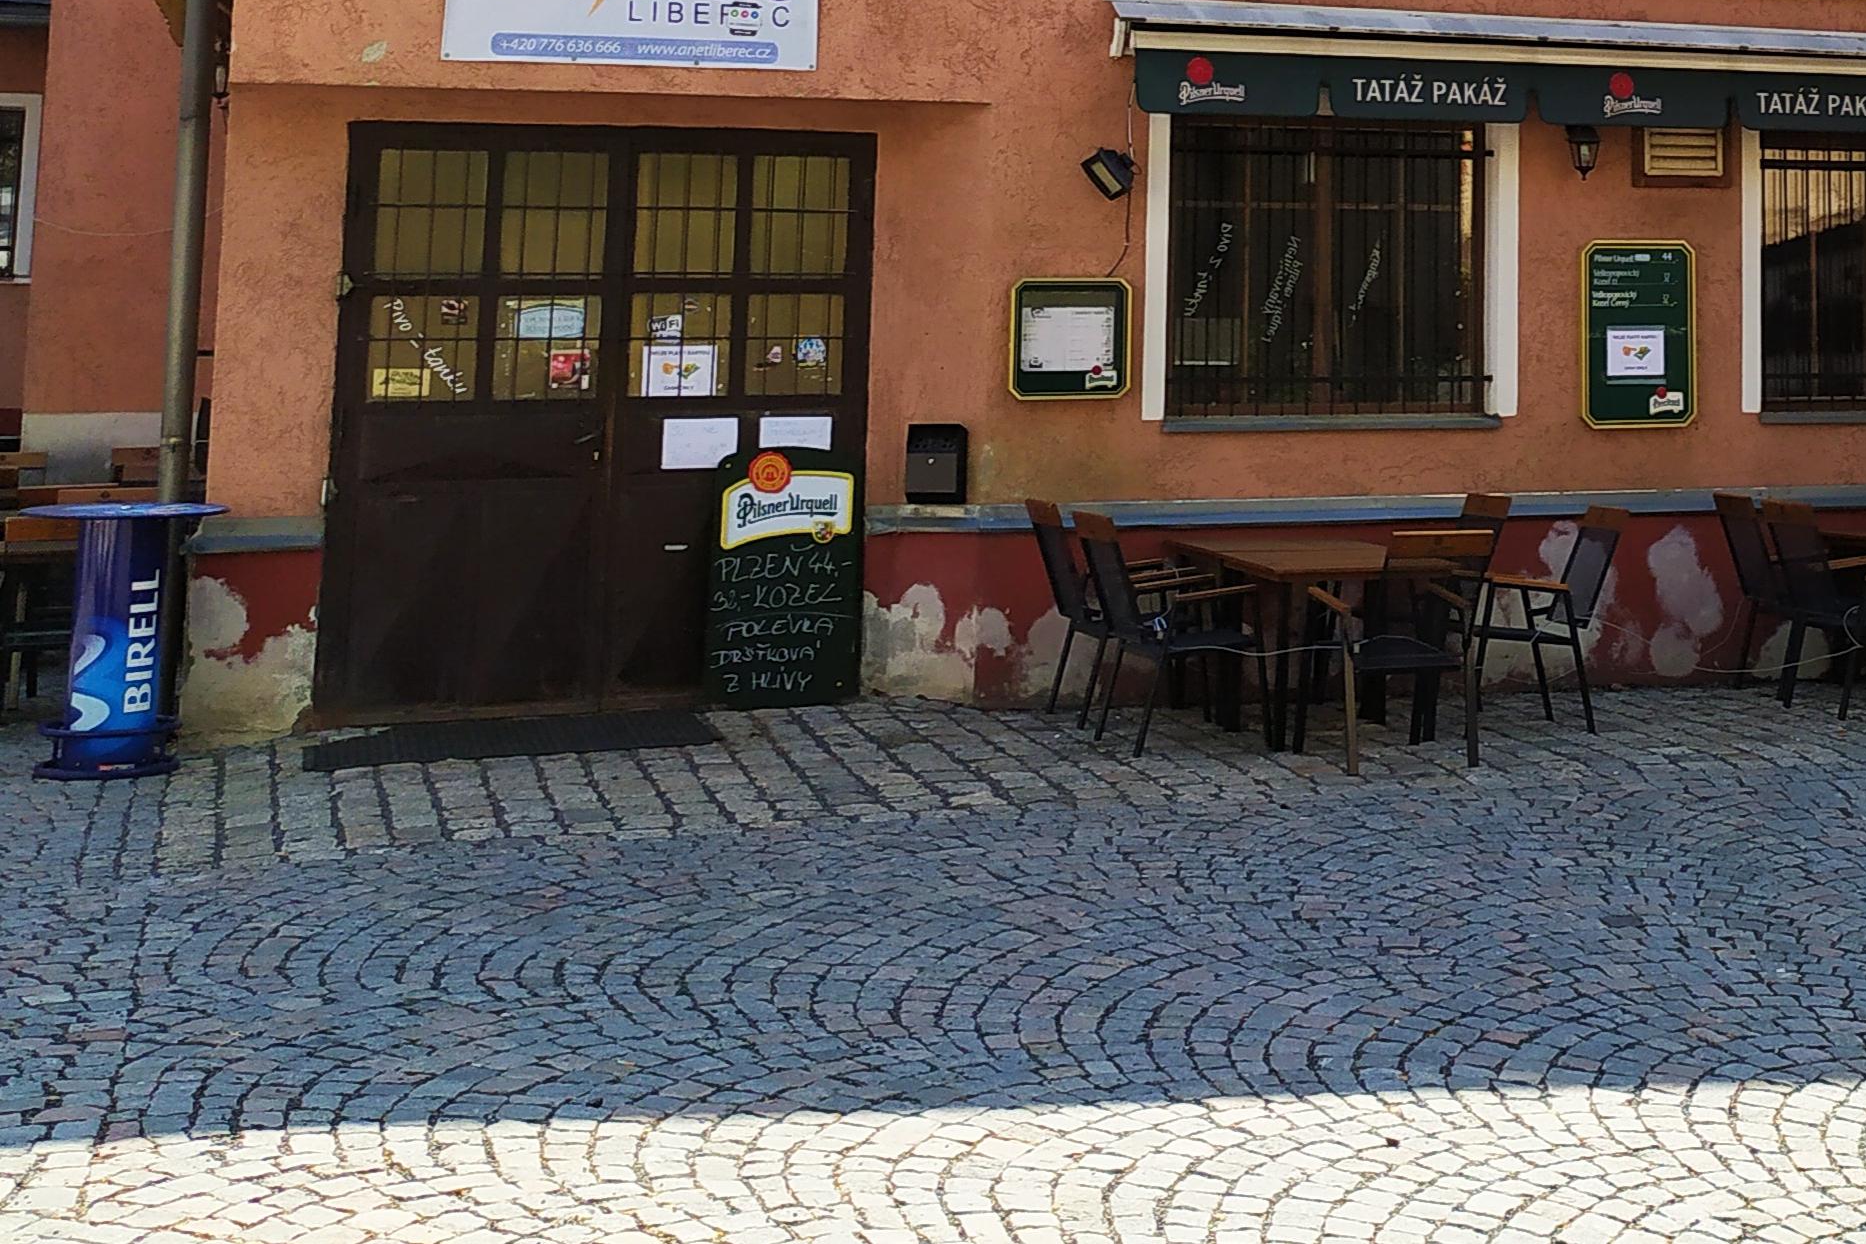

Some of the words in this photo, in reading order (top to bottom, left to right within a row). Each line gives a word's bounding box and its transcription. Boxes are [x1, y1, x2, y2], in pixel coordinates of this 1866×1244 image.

[628, 0, 790, 28] LIBERC
[500, 38, 535, 52] +420
[536, 40, 565, 53] 776
[566, 40, 594, 53] 636
[595, 41, 621, 54] 666
[637, 43, 771, 59] www.anetliberec.cz
[1352, 74, 1424, 103] TATÁŽ
[1433, 77, 1507, 106] PAKÁŽ
[1756, 87, 1820, 114] TATÁŽ
[737, 493, 789, 528] Pilsner
[787, 492, 838, 518] Urquell
[715, 544, 814, 582] PLZEŇ
[753, 583, 842, 608] KOZEL
[123, 568, 160, 714] BIRELL
[723, 674, 740, 693] Z
